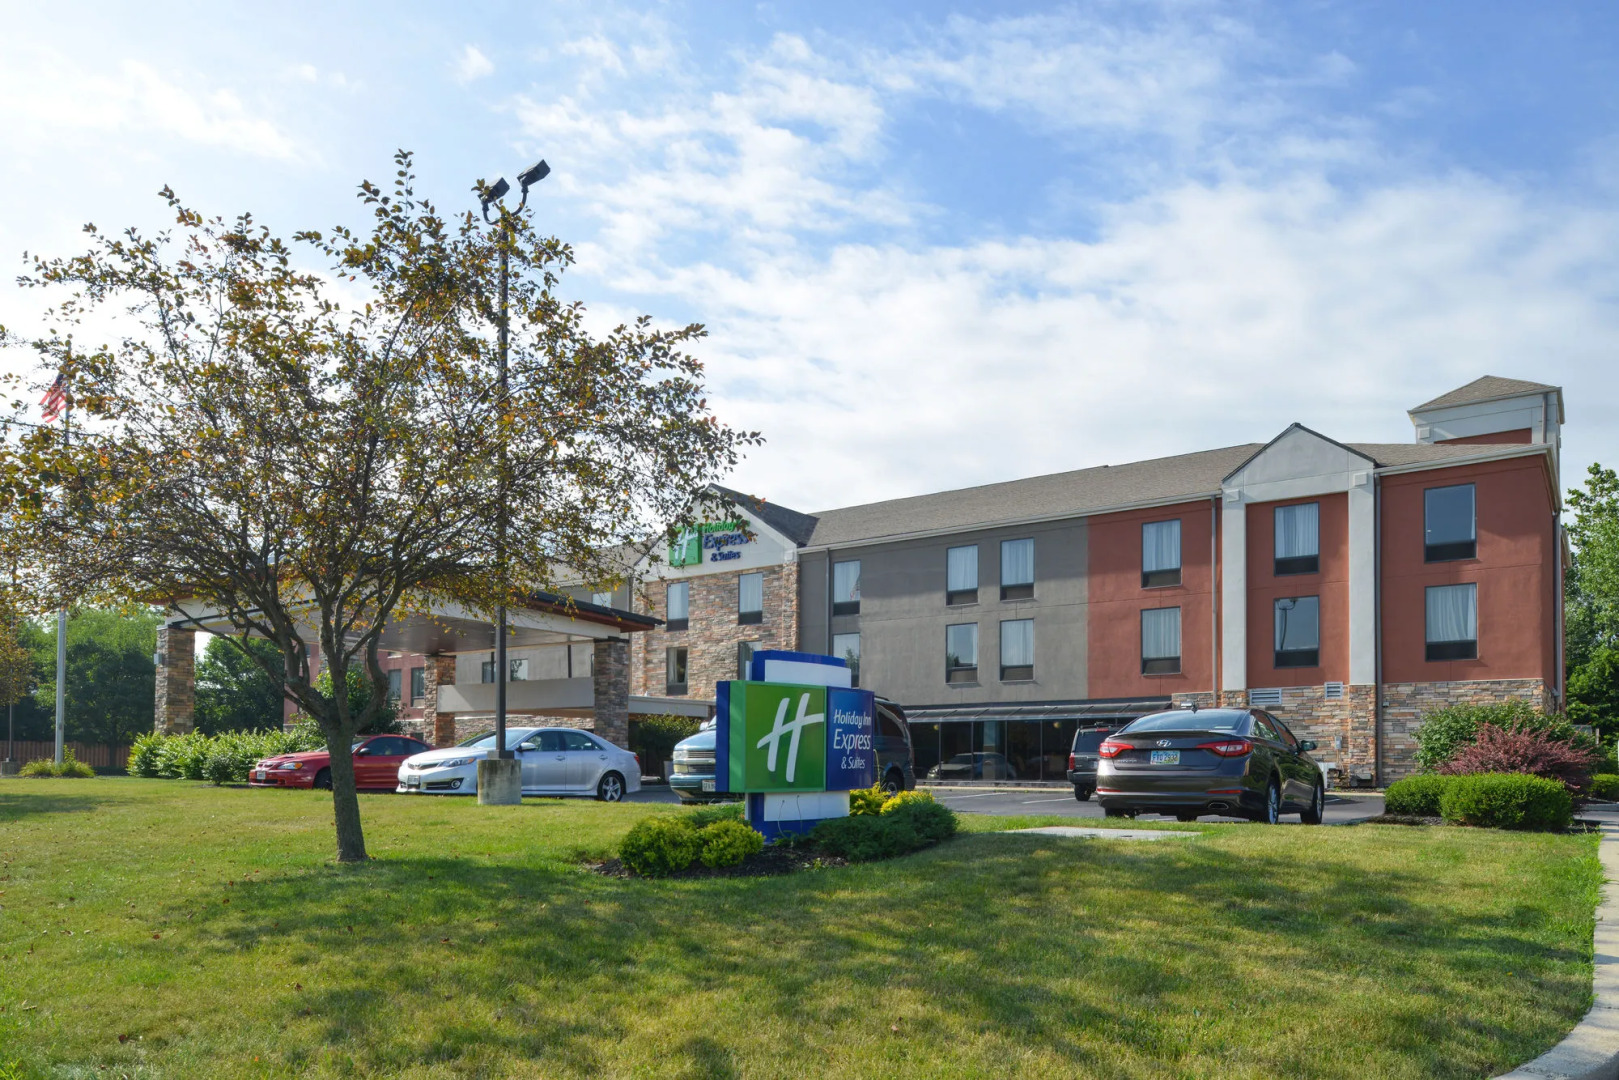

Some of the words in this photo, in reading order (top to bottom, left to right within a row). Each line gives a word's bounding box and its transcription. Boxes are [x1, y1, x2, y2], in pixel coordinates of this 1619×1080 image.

[703, 520, 736, 534] Holiday
[703, 532, 749, 551] Express
[710, 552, 718, 562] &
[718, 550, 741, 561] Suites
[833, 708, 863, 729] Holiday
[863, 711, 871, 726] Inn
[833, 728, 871, 755] Express
[840, 756, 847, 769] &
[848, 756, 865, 770] Suites
